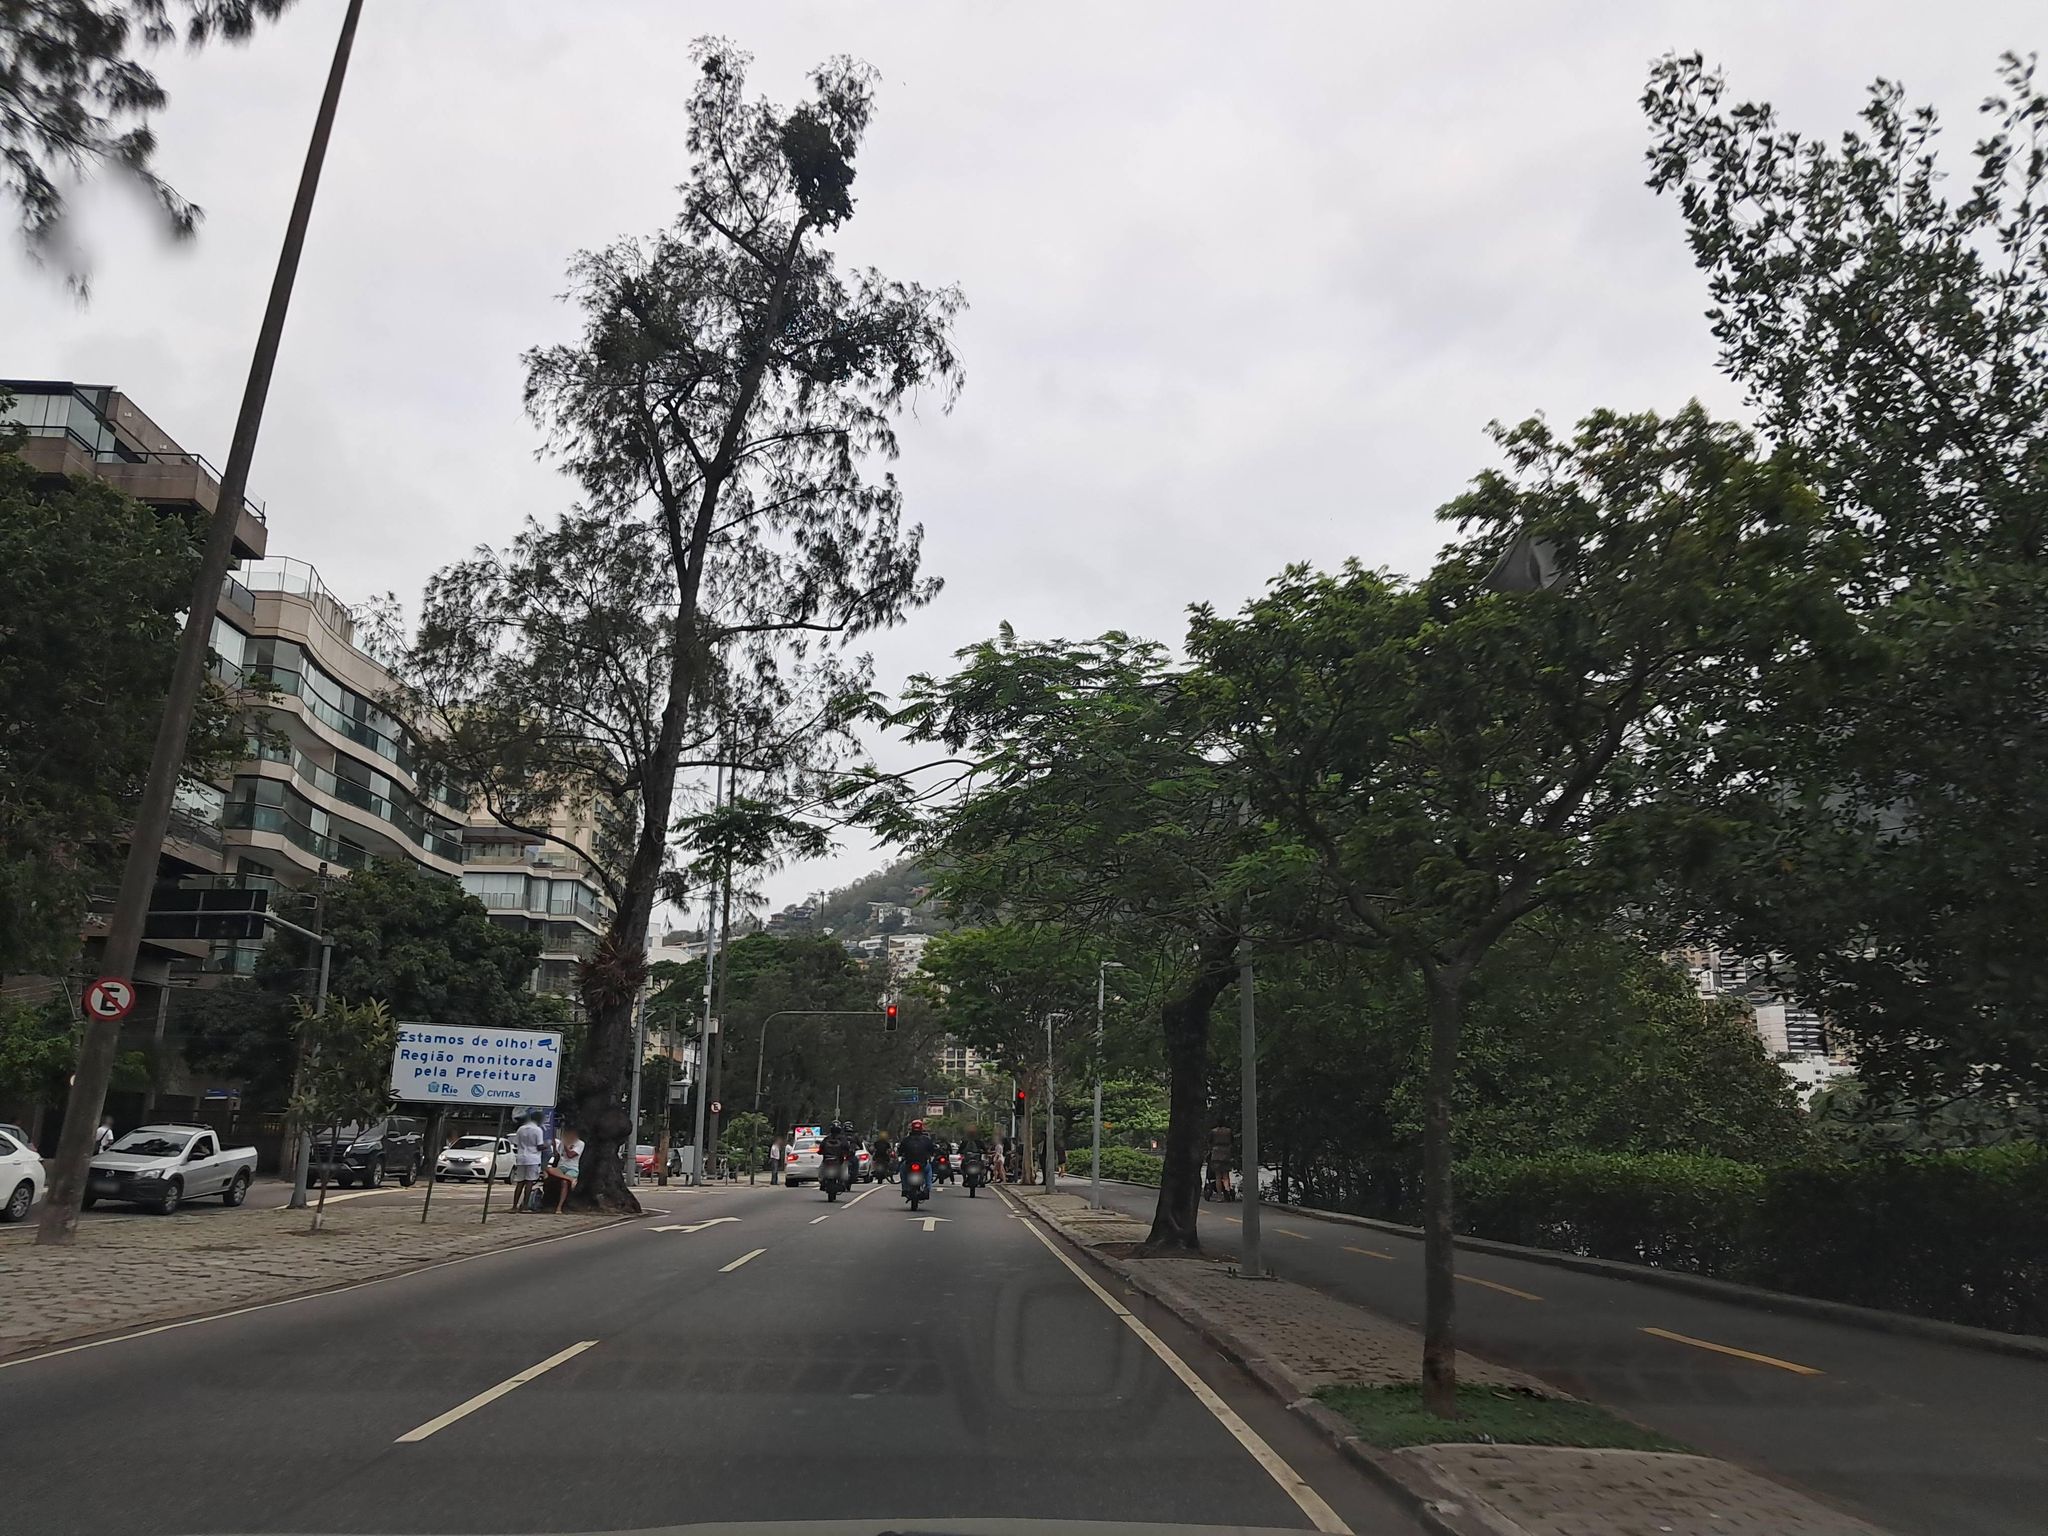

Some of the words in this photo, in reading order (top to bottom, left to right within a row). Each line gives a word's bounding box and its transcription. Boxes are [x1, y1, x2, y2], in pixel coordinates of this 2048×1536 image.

[100, 987, 120, 1011] E
[400, 1031, 464, 1046] Estamos
[472, 1035, 489, 1047] de
[496, 1037, 533, 1049] olho!
[400, 1049, 454, 1063] Região
[463, 1055, 552, 1068] monitorada
[414, 1067, 447, 1079] pela
[456, 1067, 536, 1082] Prefeitura
[441, 1083, 458, 1094] Rio
[487, 1090, 521, 1099] CIVITAS
